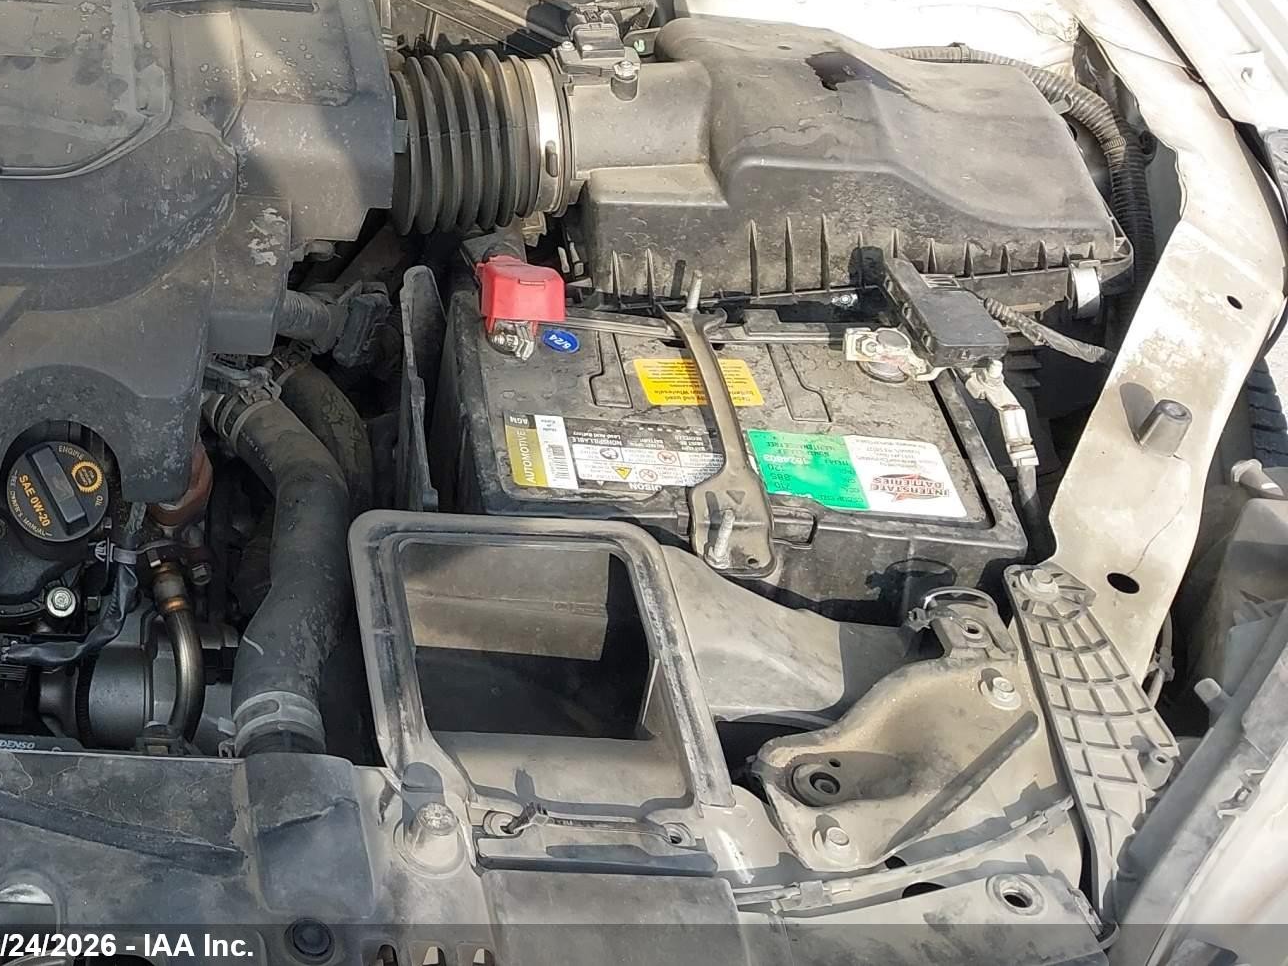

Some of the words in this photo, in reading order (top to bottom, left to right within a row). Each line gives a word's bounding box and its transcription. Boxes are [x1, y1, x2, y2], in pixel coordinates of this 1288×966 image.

[509, 416, 528, 425] AGM
[58, 445, 85, 460] ENGINE
[516, 430, 536, 484] AUTOMOTIVE
[629, 482, 663, 491] OISON
[872, 477, 944, 489] BATTERIES
[871, 483, 950, 497] INTERSTATE
[19, 474, 36, 497] SAE
[30, 496, 51, 528] 0W-20
[95, 495, 104, 507] OIL
